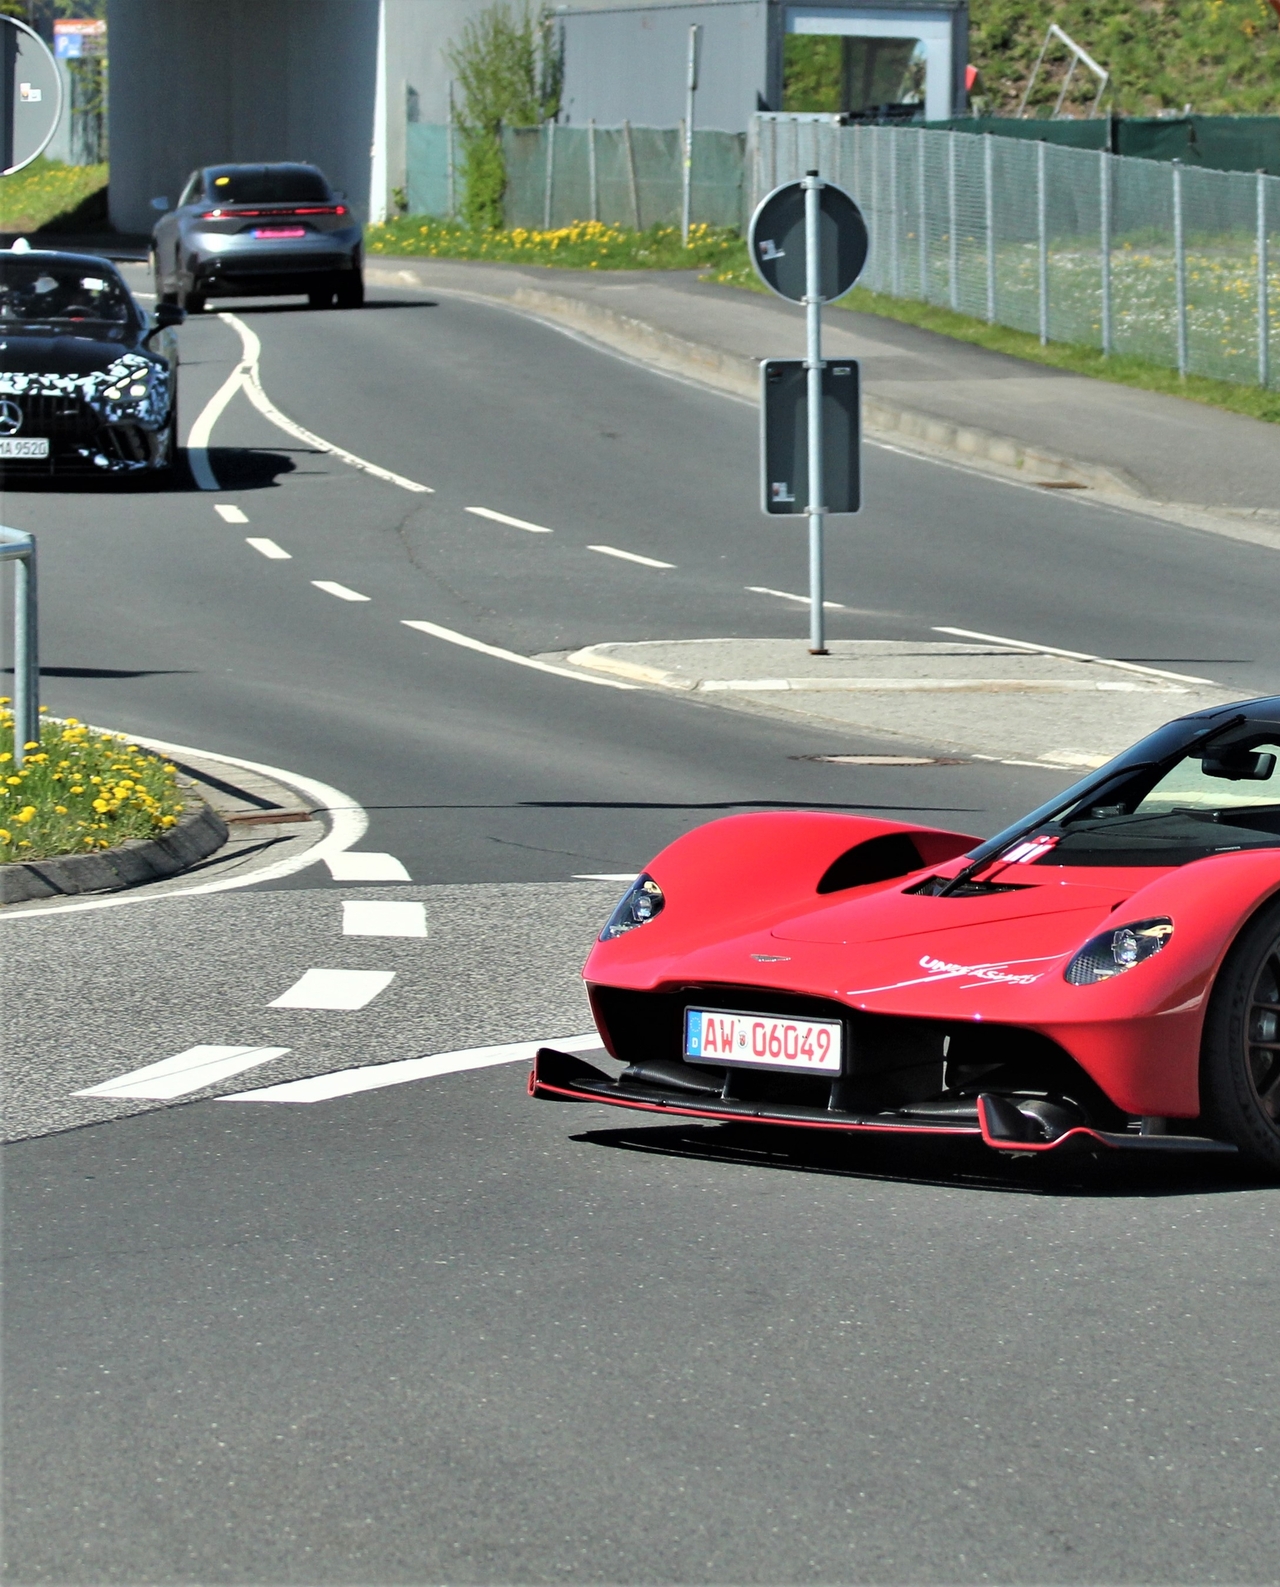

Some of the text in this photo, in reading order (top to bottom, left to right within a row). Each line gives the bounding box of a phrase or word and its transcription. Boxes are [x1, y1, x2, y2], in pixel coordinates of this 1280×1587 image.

[15, 441, 47, 455] 9520
[703, 1017, 735, 1054] AW
[752, 1022, 831, 1063] 06049
